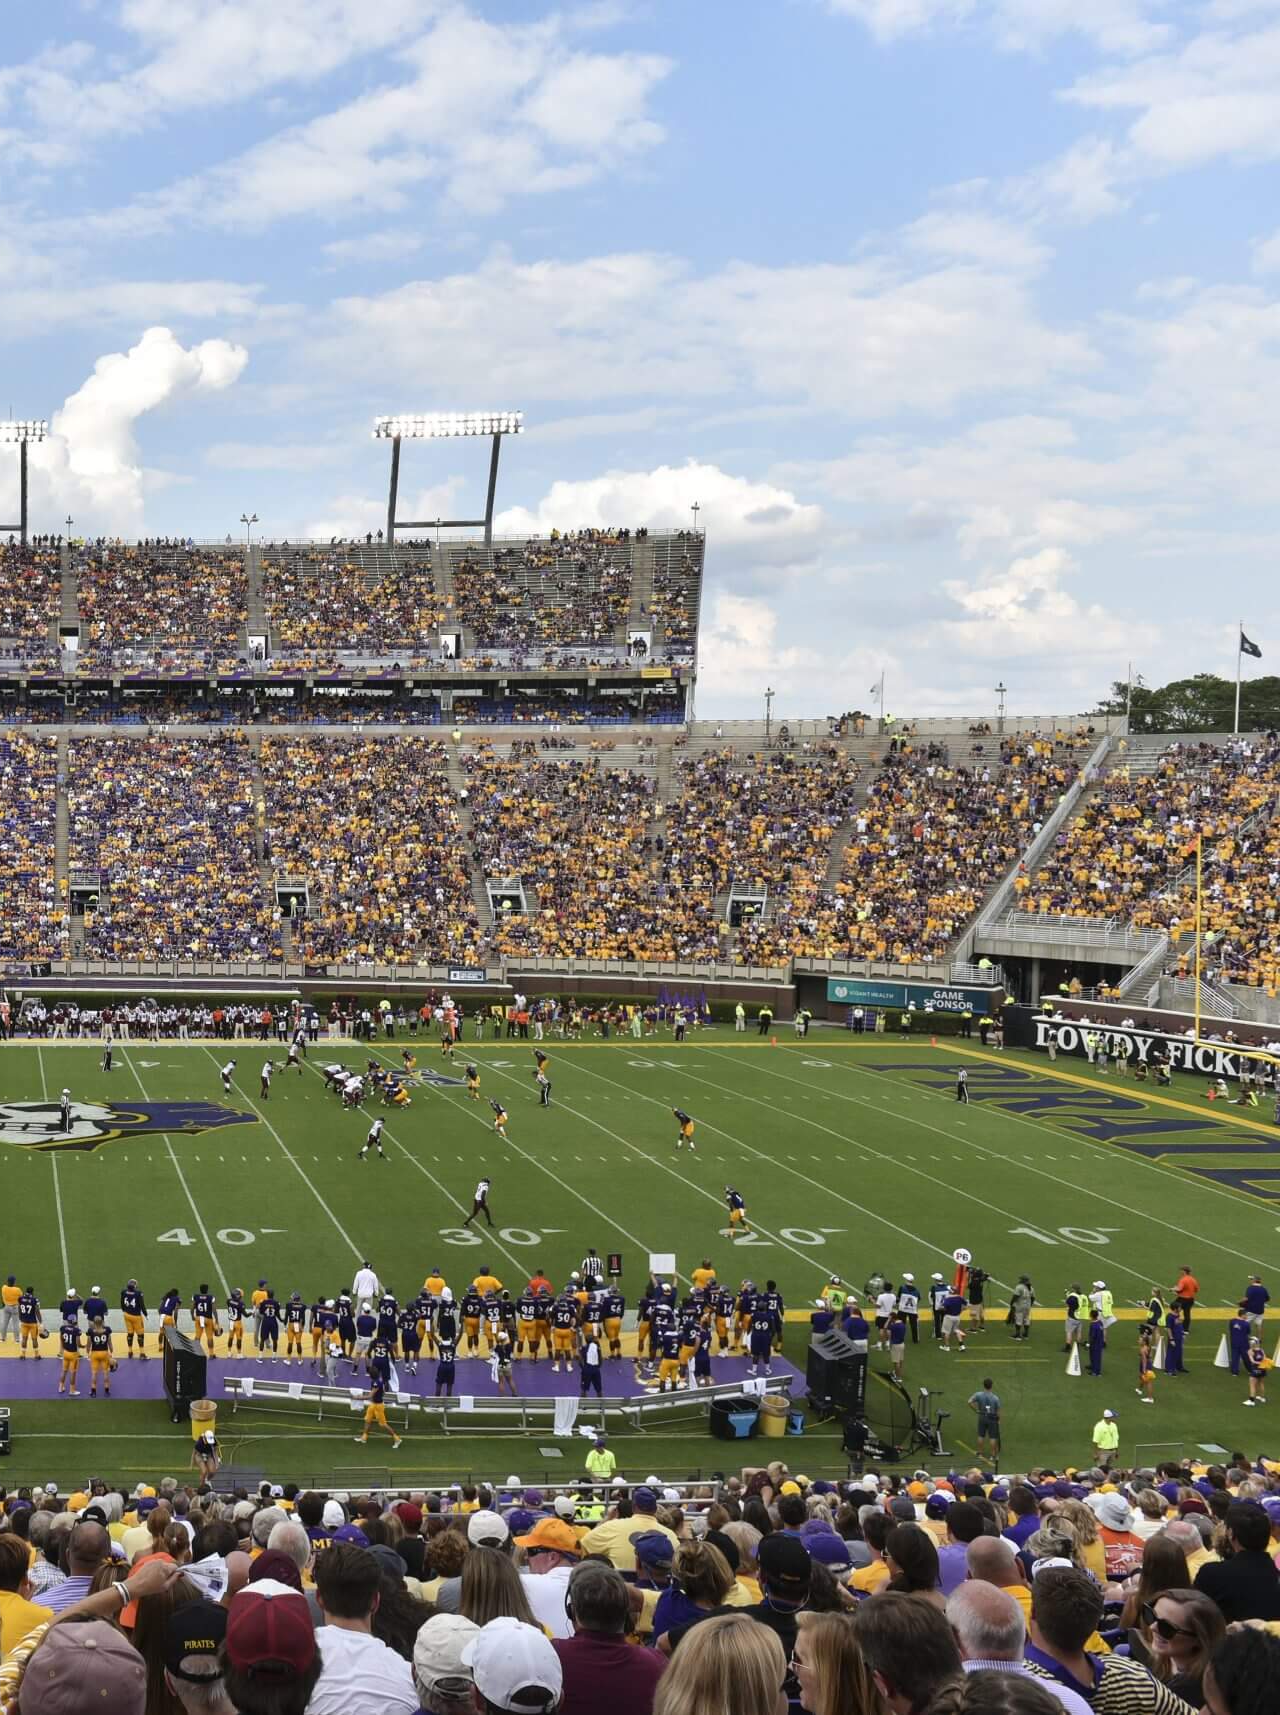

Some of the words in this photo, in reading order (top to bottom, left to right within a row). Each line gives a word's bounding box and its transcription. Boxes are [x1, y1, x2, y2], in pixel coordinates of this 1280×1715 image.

[932, 990, 965, 1000] GAME
[923, 998, 973, 1010] SPONSOR
[156, 1227, 257, 1247] 40
[438, 1228, 543, 1247] 30
[719, 1227, 827, 1246] 20
[1007, 1227, 1111, 1246] 10
[20, 1304, 33, 1315] 87
[197, 1300, 208, 1312] 61
[420, 1306, 431, 1316] 51
[521, 1305, 535, 1316] 98
[290, 1310, 301, 1321] 31
[557, 1311, 570, 1323] 50
[754, 1320, 770, 1330] 69
[63, 1333, 73, 1345] 91
[374, 1347, 387, 1359] 25
[440, 1352, 453, 1362] 35
[184, 1639, 216, 1650] PIRATES
